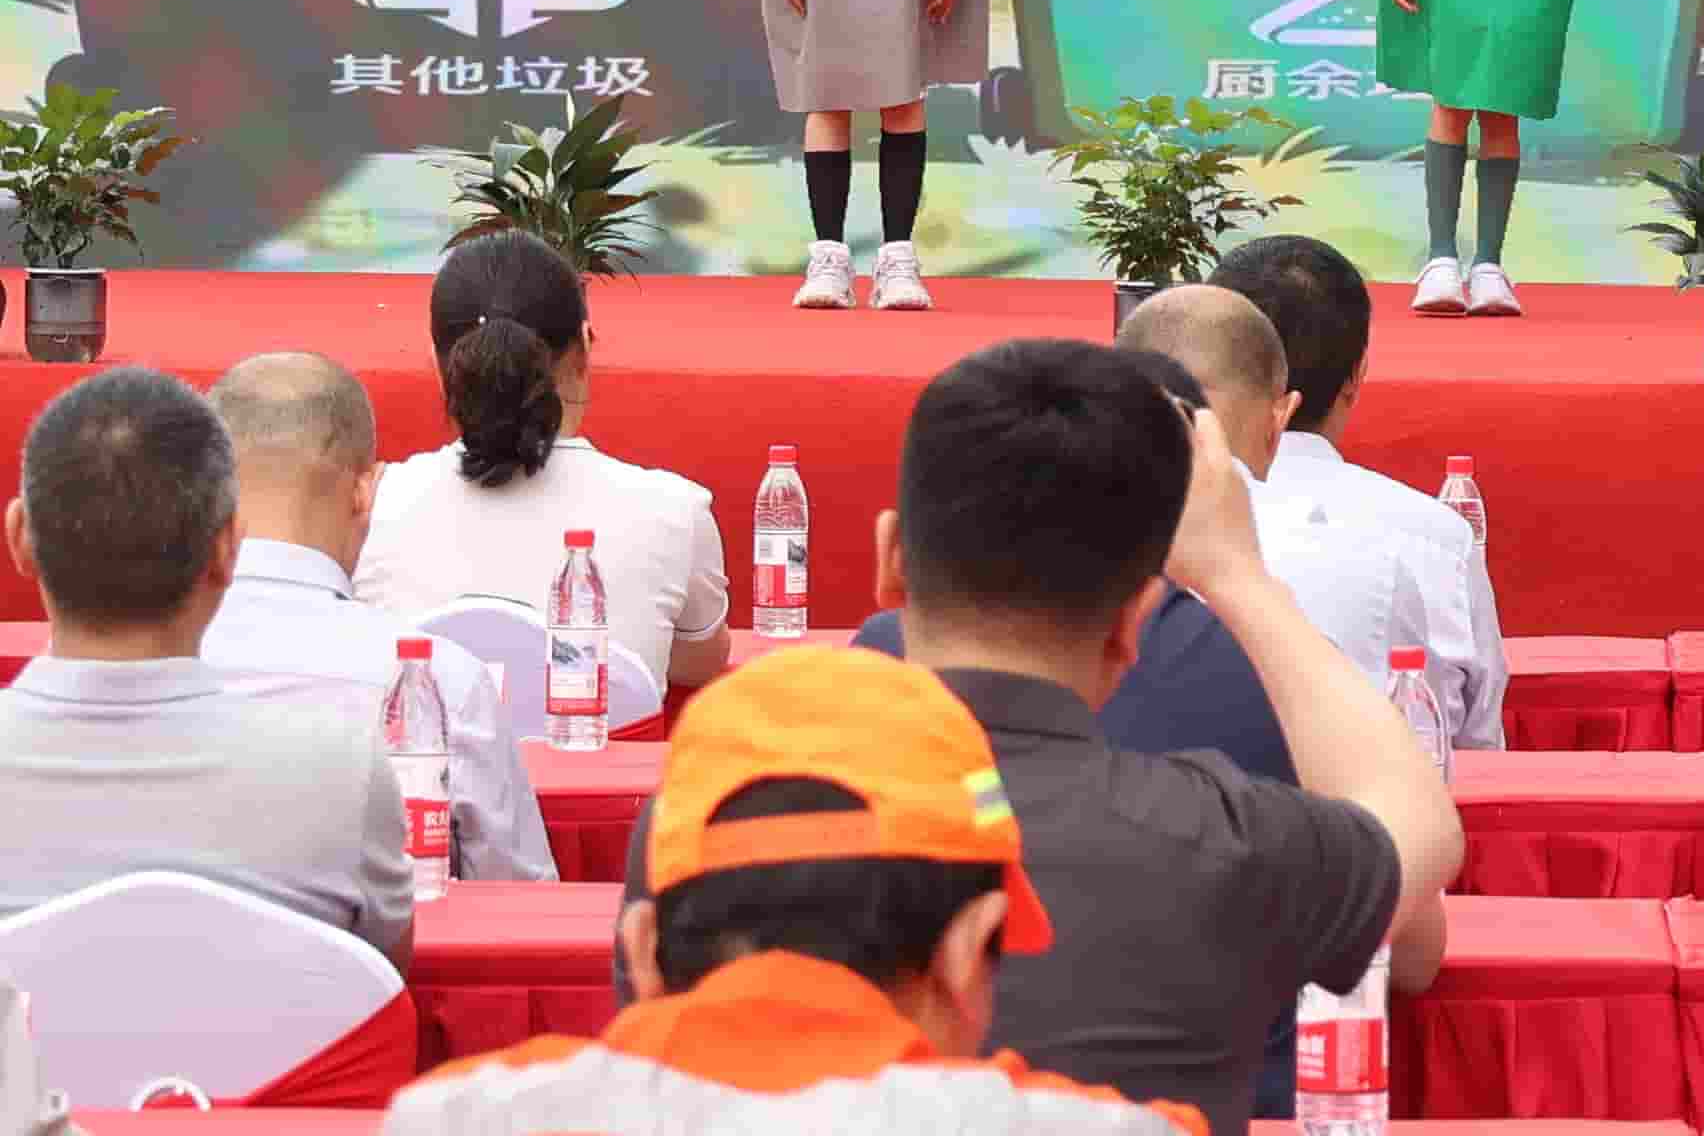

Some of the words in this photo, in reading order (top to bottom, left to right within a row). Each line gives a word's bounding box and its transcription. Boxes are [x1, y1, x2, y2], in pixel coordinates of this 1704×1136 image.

[329, 53, 654, 97] 其他垃圾
[1201, 58, 1433, 101] 厨余
